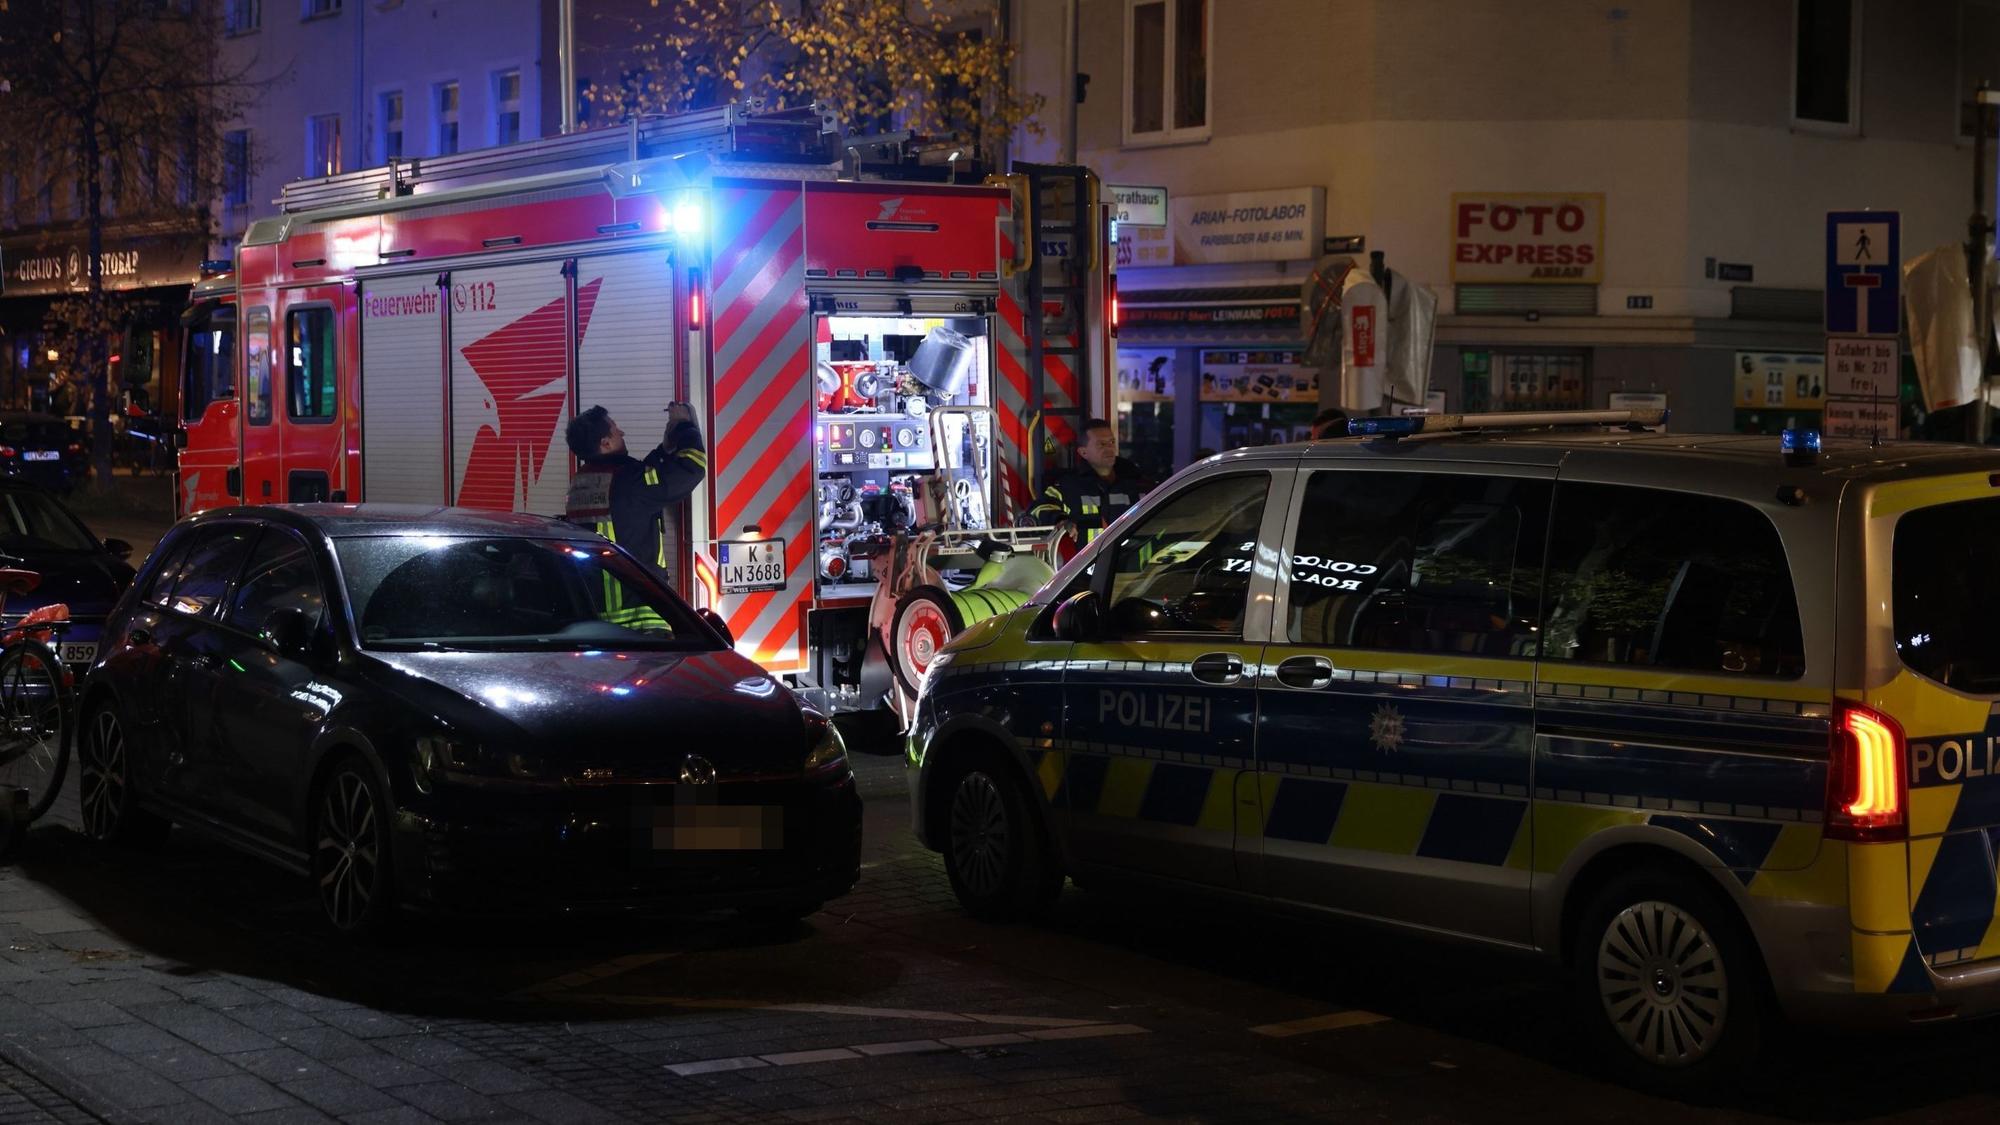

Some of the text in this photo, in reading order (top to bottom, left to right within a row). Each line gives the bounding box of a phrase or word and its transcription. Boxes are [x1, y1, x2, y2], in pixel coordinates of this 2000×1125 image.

[1191, 205, 1305, 225] ARIAN-FOTOLABOR
[1458, 203, 1585, 238] FOTO
[1257, 233, 1269, 244] AB
[1455, 243, 1594, 265] EXPRESS
[20, 256, 62, 282] GIGLIO'S
[1530, 266, 1584, 278] ARIAN
[365, 285, 438, 318] Feuerwehr
[469, 281, 496, 312] 112
[1834, 343, 1891, 358] Zufahrt bis
[748, 545, 758, 562] K
[725, 563, 781, 583] LN 3688
[66, 646, 94, 660] 859
[1099, 689, 1212, 733] POLIZEI
[1911, 735, 2000, 784] POLI
